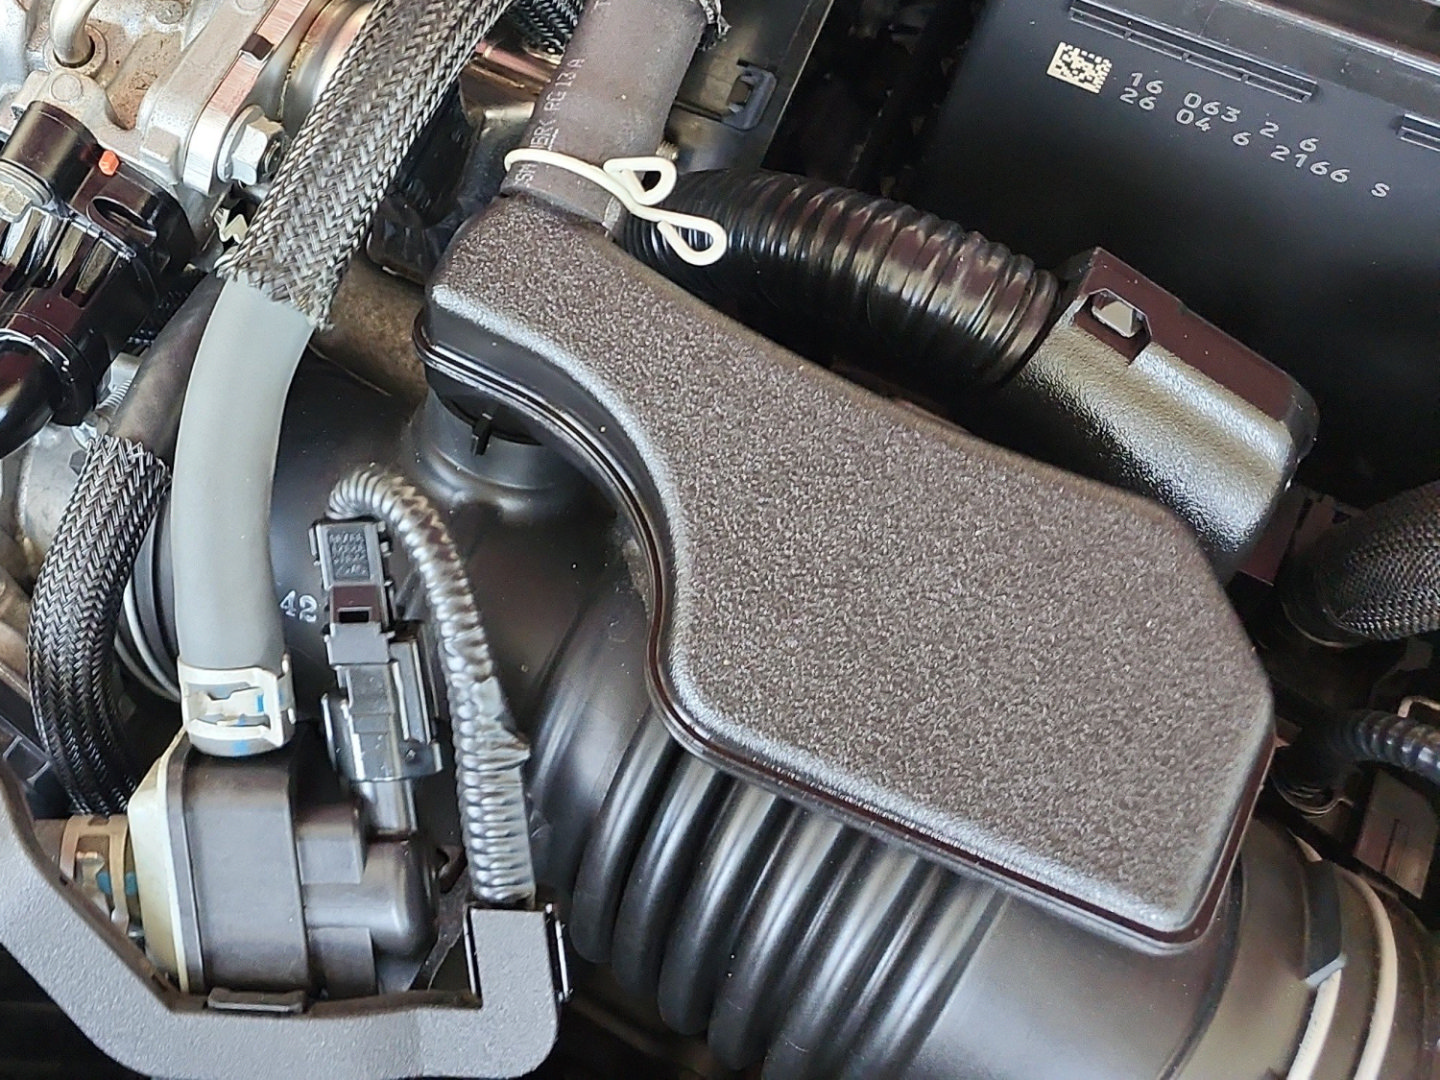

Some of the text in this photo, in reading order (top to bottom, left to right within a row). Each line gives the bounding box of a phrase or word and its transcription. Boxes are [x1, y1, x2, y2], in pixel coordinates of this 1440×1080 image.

[1131, 72, 1164, 95] 16
[1120, 88, 1157, 111] 26
[1175, 108, 1211, 132] 04
[1270, 144, 1350, 183] 2166
